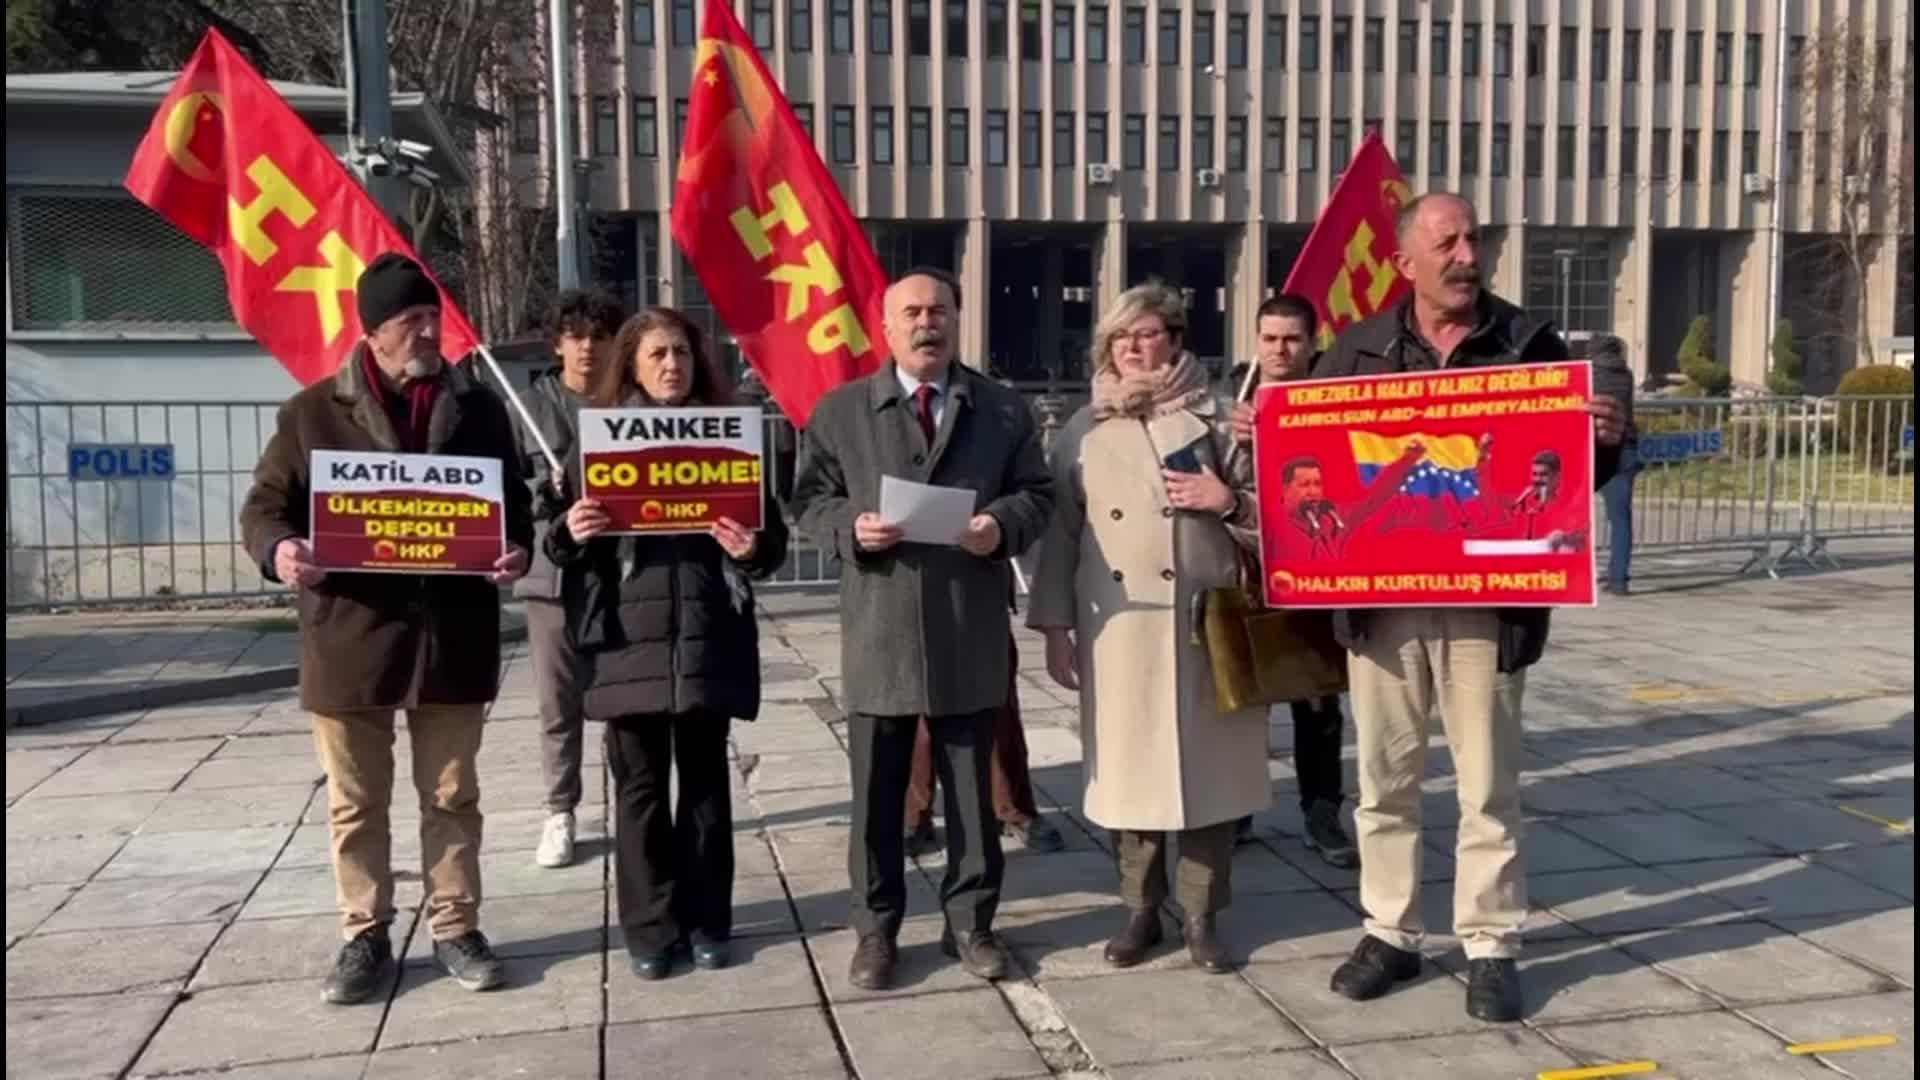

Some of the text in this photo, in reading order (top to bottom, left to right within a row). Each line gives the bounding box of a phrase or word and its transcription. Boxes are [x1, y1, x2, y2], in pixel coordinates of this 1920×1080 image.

[1288, 383, 1374, 406] VENEZUELA
[604, 416, 743, 440] YANKEE
[1279, 408, 1377, 428] KAHROLSUN
[331, 460, 485, 484] KATİL ABD
[587, 459, 761, 487] GO HOME!
[327, 494, 490, 517] ÜLKEMİZDEN
[665, 503, 708, 518] HKP
[365, 519, 456, 538] DEFOL!
[400, 543, 446, 559] HKP
[1297, 569, 1567, 595] HALKIN KURTULUŞ PARTİSİ
